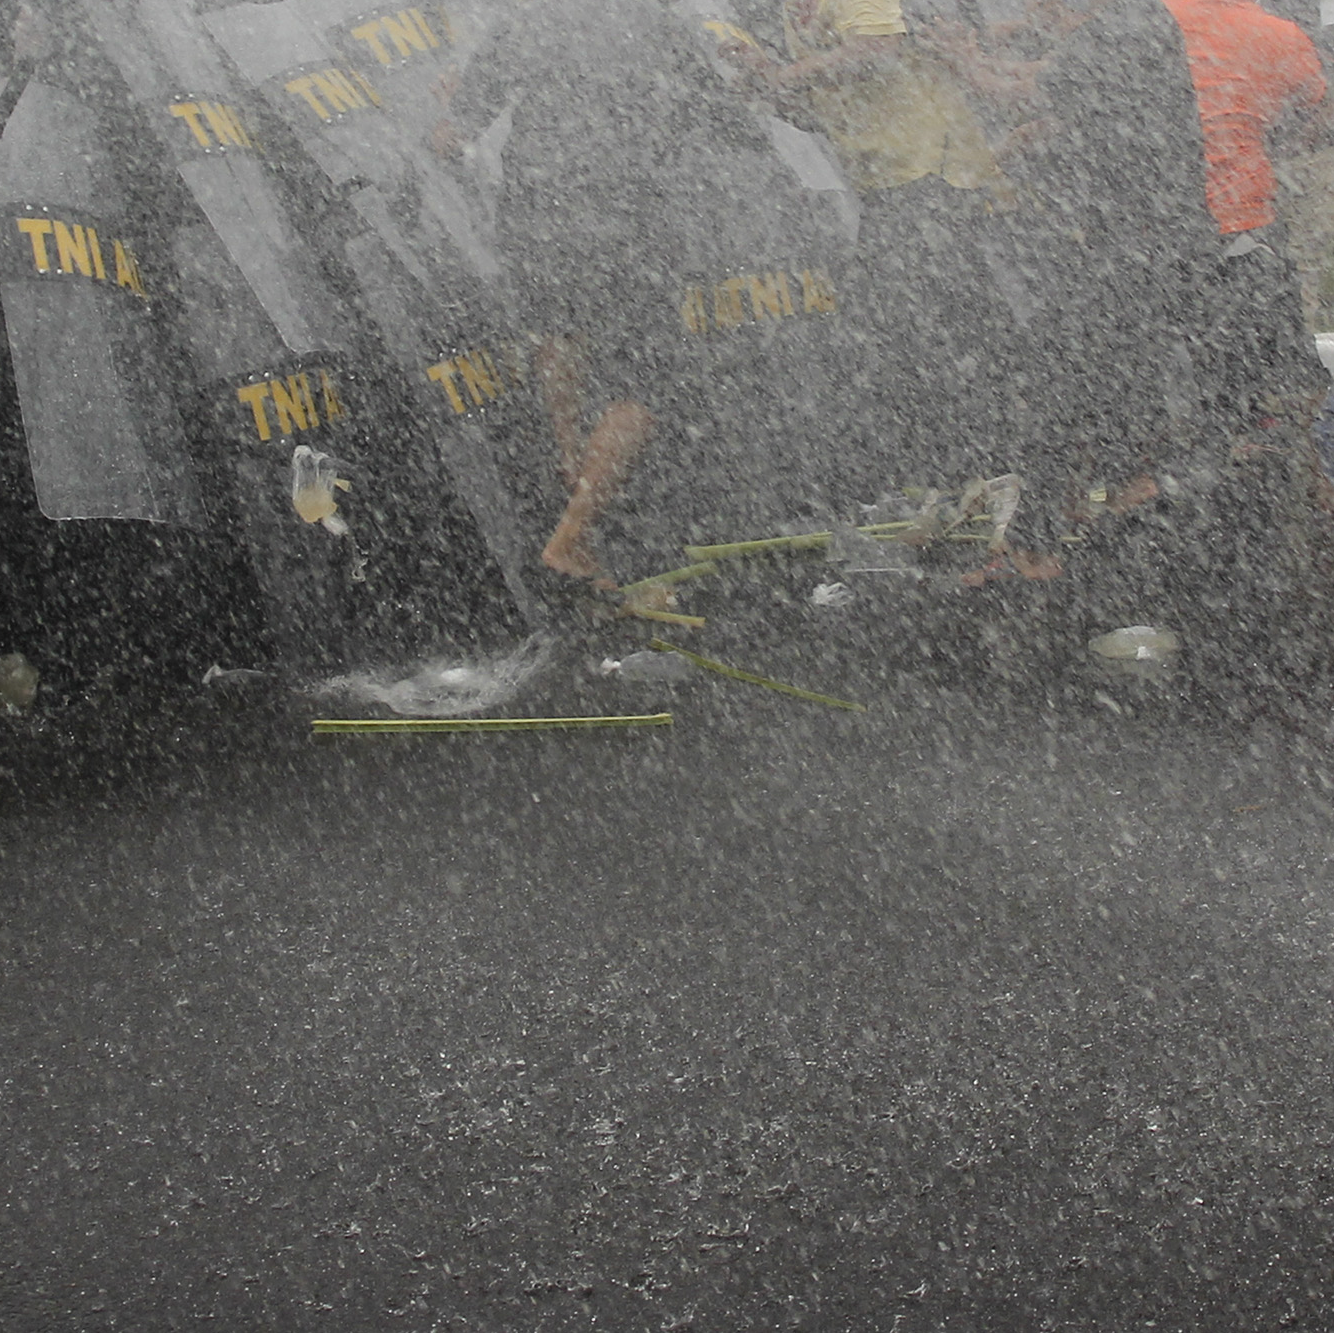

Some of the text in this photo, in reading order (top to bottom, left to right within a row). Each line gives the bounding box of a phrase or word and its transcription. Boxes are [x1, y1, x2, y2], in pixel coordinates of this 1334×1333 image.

[351, 7, 440, 65] TNI
[285, 68, 368, 119] TNI
[169, 101, 252, 148] TNI
[17, 218, 106, 279] TNI
[237, 372, 320, 441] TNI
[427, 348, 505, 413] TNI
